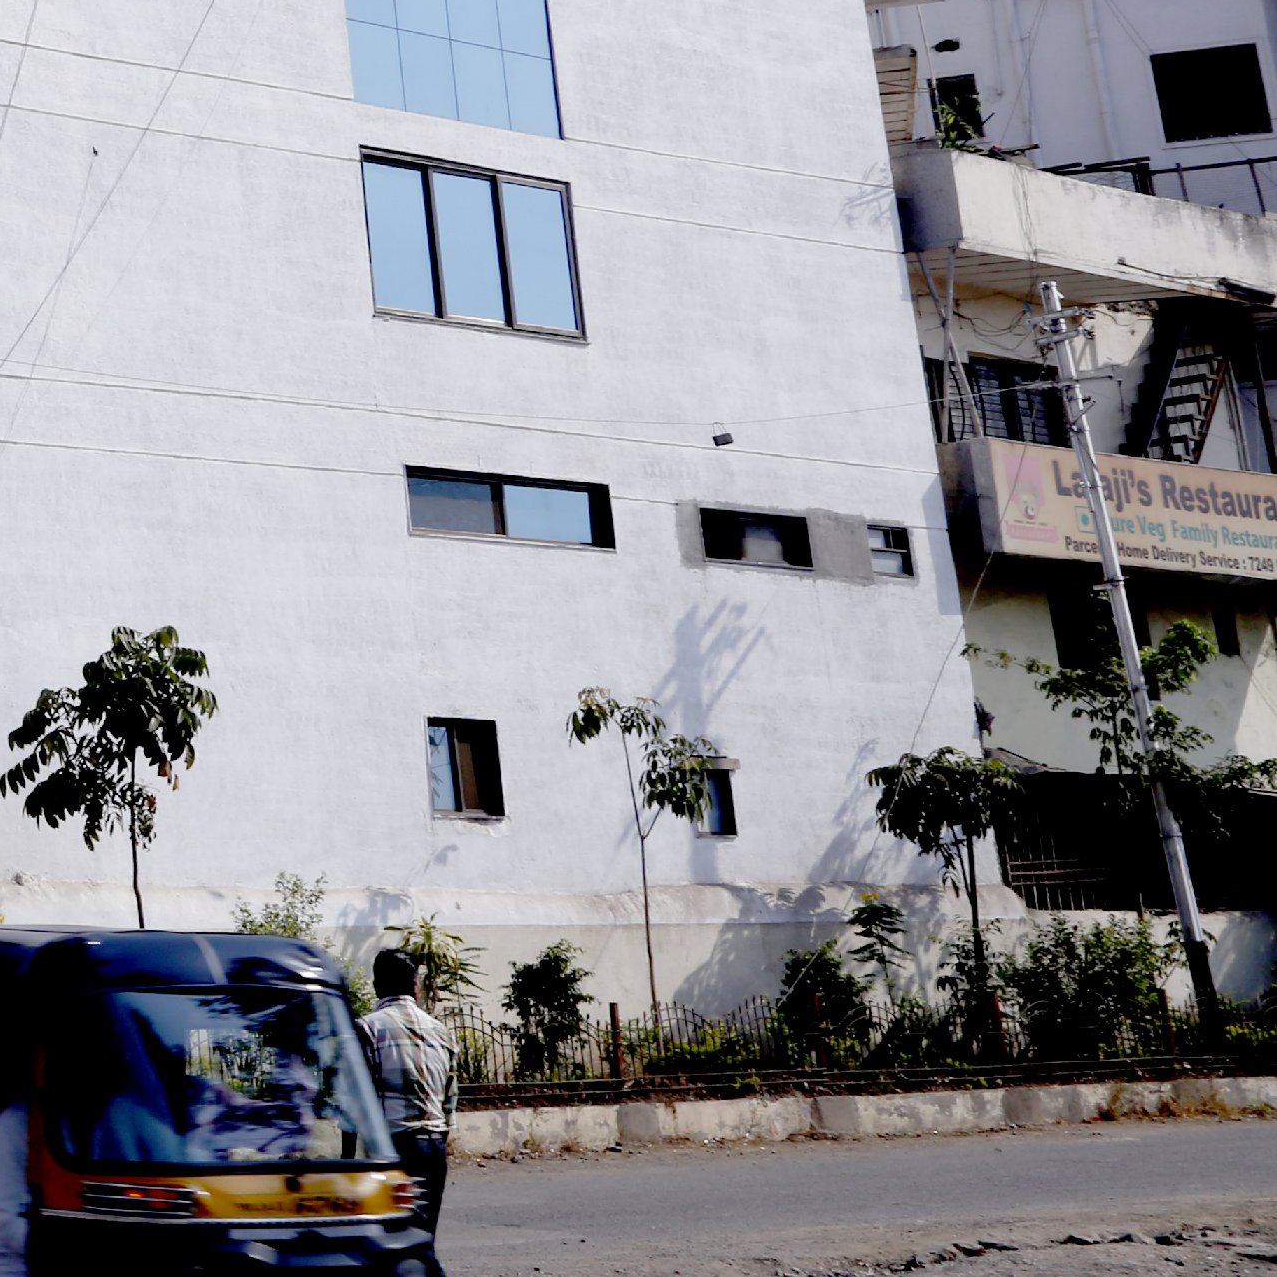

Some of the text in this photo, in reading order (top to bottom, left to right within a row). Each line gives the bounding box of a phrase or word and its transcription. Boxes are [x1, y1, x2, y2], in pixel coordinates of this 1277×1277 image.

[1051, 459, 1153, 513] Laaji's
[1108, 516, 1136, 535] ure
[1136, 514, 1167, 543] Veg
[1170, 518, 1218, 549] Family
[1065, 535, 1098, 554] Parce
[1116, 540, 1150, 560] Home
[1152, 544, 1197, 568] Delivery
[1199, 550, 1240, 570] Service
